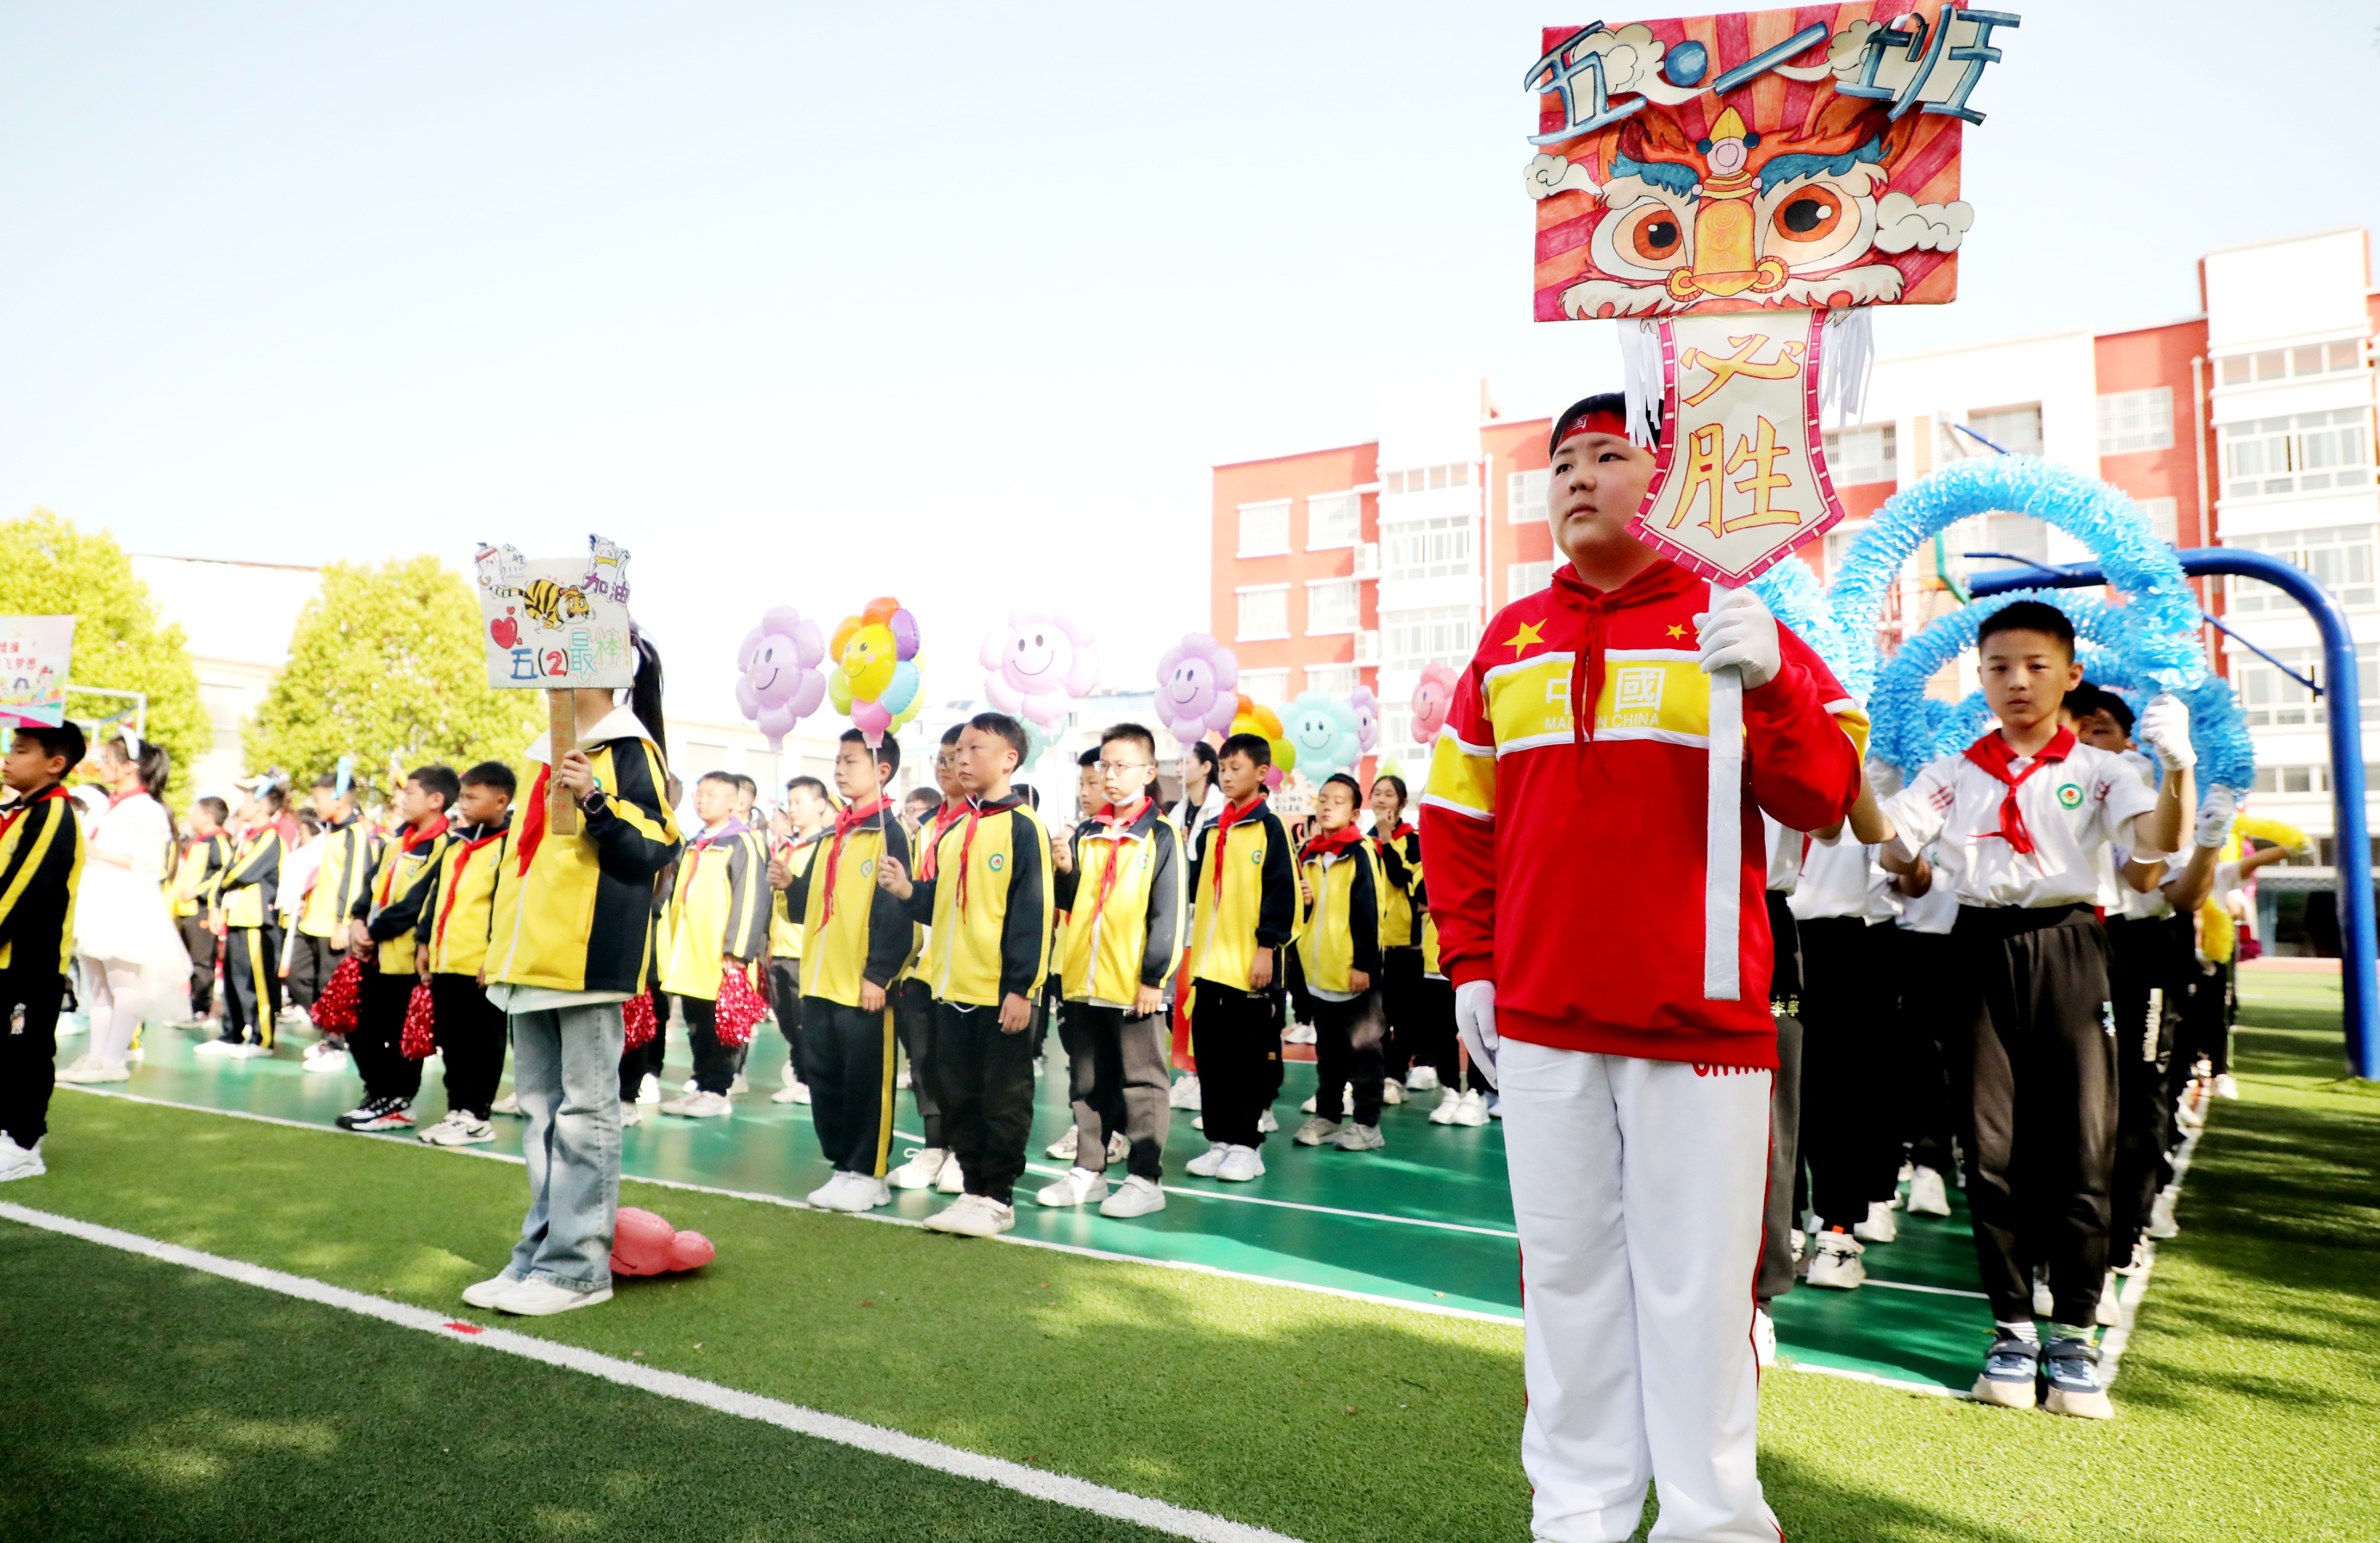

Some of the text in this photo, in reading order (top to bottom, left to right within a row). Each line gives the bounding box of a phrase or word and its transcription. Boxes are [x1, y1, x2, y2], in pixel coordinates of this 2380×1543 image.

[1667, 334, 1805, 539] 必胜
[581, 572, 629, 604] 加油
[0, 657, 36, 670] 飞梦想
[1545, 717, 1574, 730] MAD
[1612, 713, 1659, 728] CHINA
